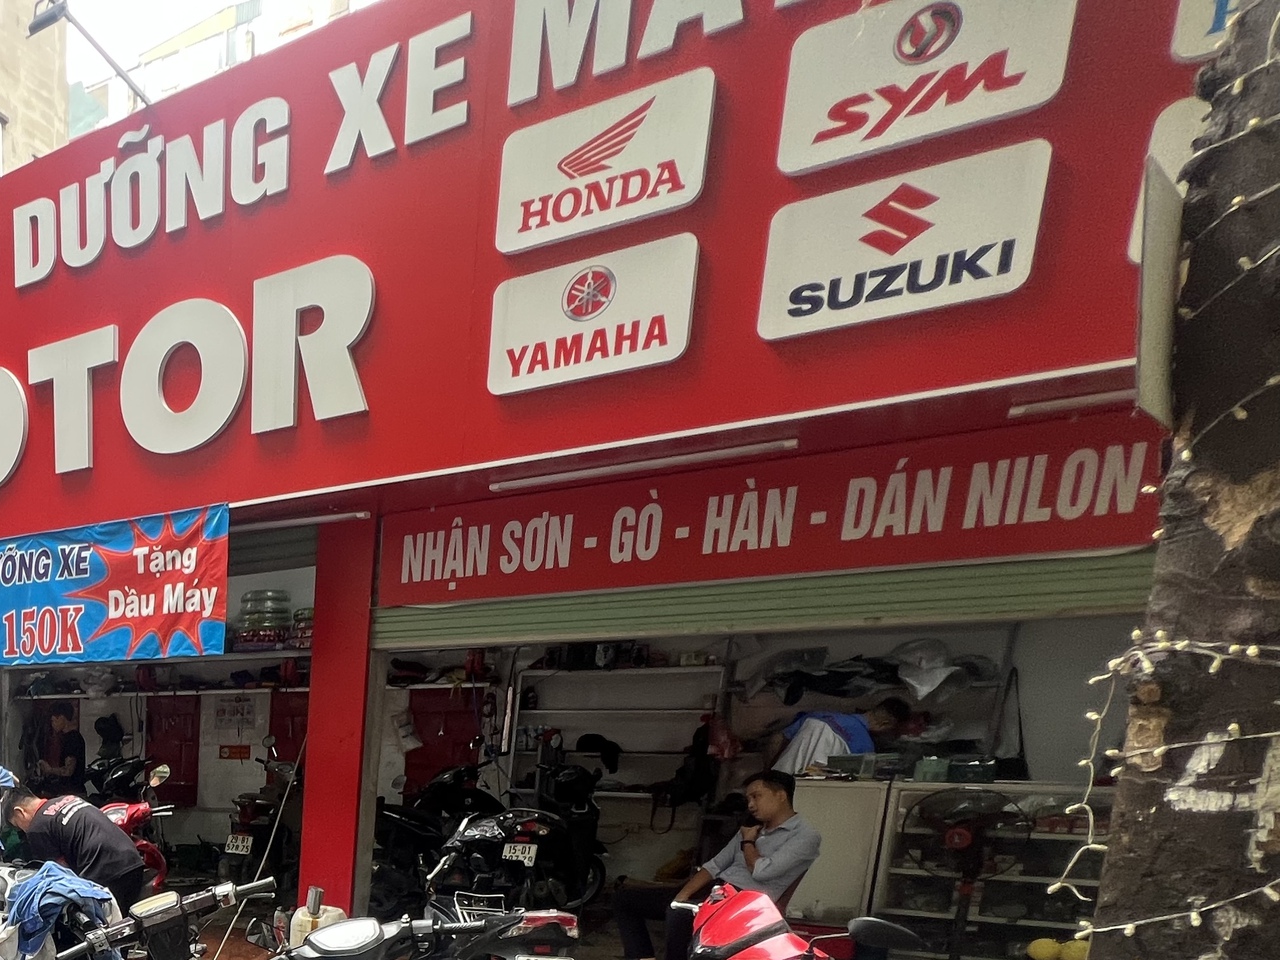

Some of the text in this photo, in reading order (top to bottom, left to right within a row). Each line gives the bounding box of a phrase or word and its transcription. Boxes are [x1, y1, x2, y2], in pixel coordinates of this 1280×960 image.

[813, 48, 1026, 145] SYM
[13, 97, 292, 289] DƯỠNG
[323, 11, 474, 176] XE
[517, 157, 685, 235] HONDA
[786, 238, 1017, 318] SUZUKI
[506, 314, 669, 378] YAMAHA
[400, 522, 489, 591] NHẬN
[498, 508, 574, 574] SƠN
[609, 489, 663, 562] GÒ
[702, 482, 799, 555] HÀN
[840, 456, 952, 542] DÁN
[962, 440, 1149, 529] NILON
[56, 543, 93, 581] XE
[132, 544, 198, 578] Tặng
[4, 604, 85, 658] 150K
[108, 577, 218, 620] Dầu Máy
